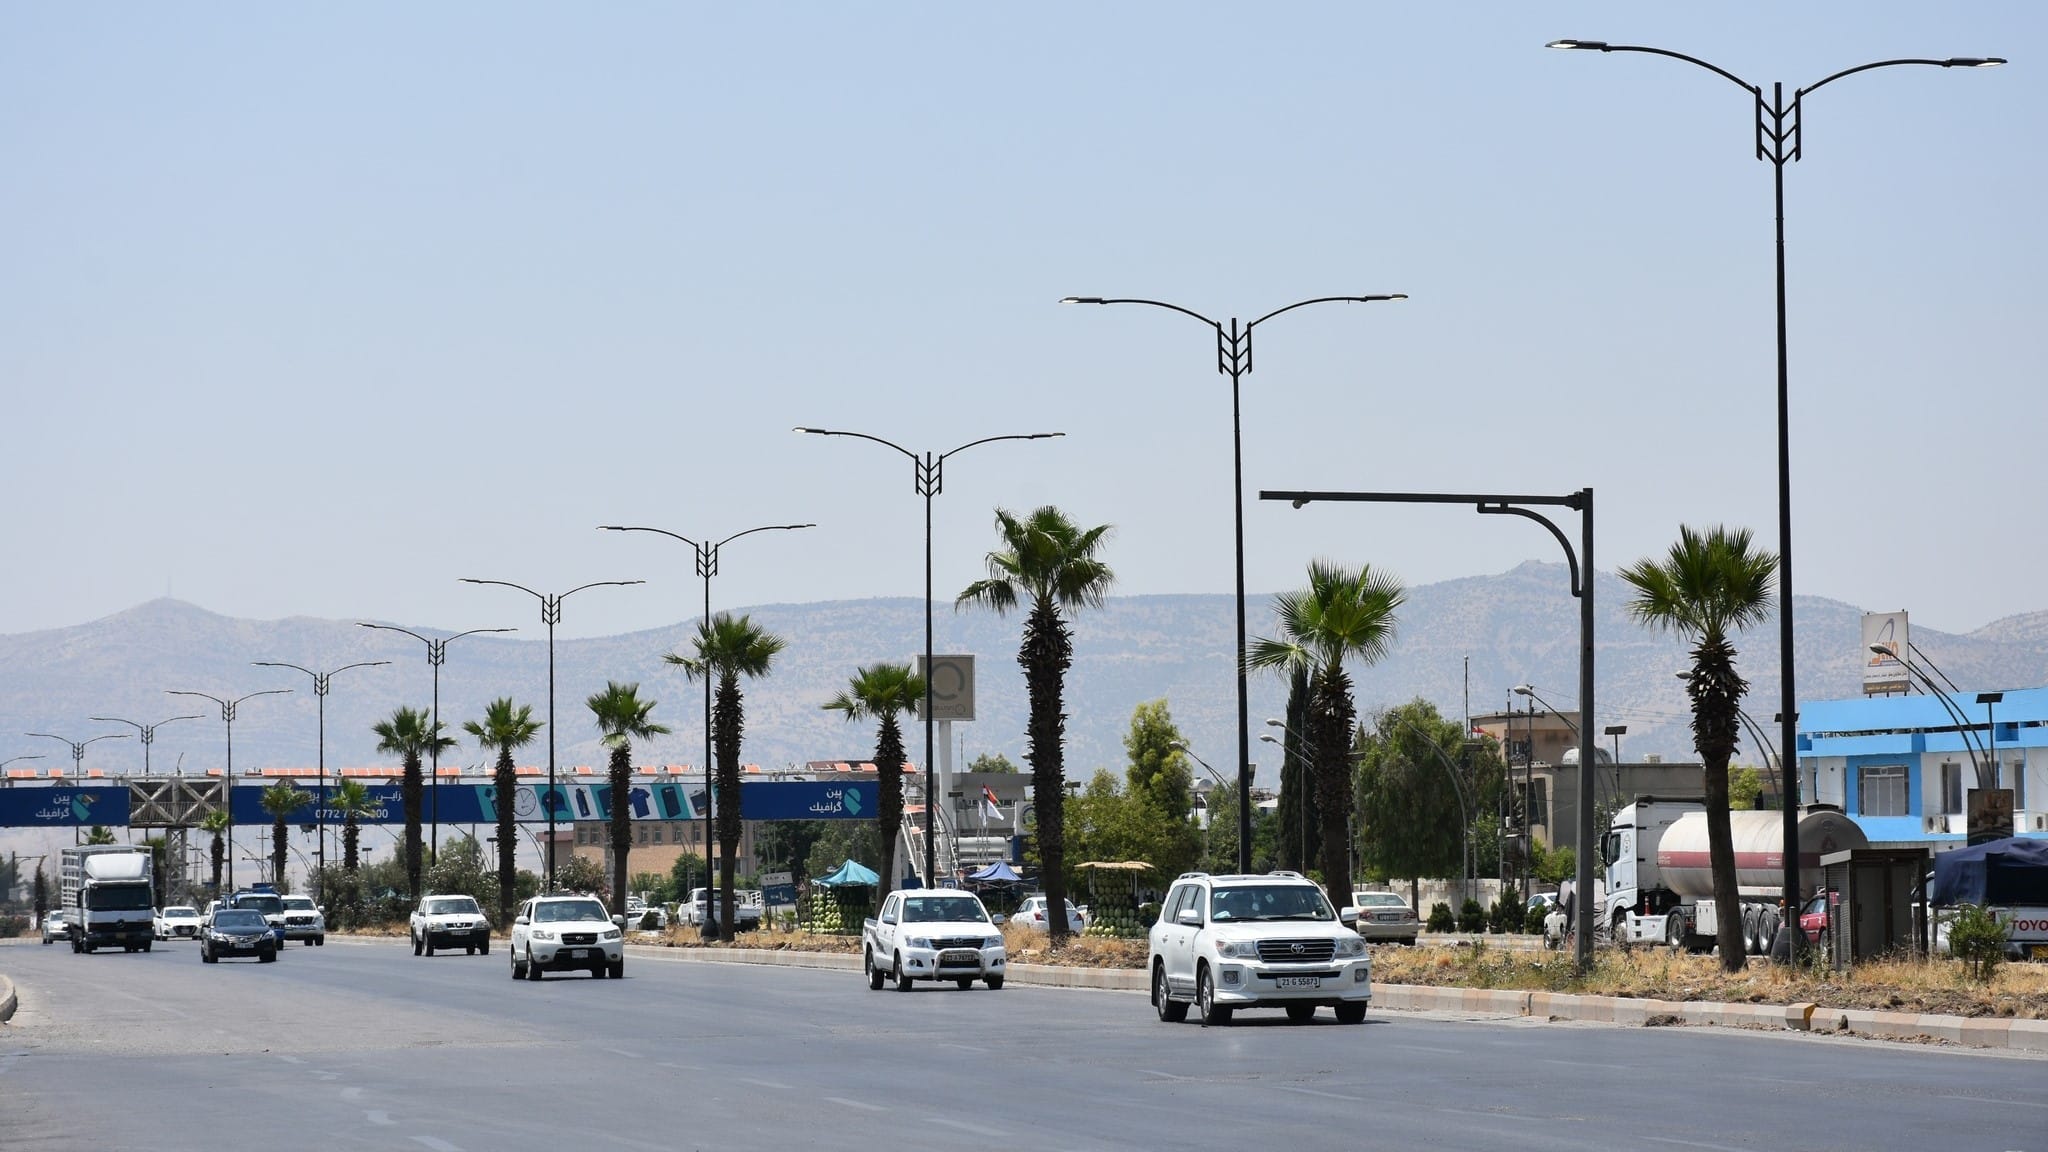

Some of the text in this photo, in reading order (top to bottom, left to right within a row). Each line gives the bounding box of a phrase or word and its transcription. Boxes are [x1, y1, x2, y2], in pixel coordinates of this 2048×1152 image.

[315, 809, 340, 818] 0772
[2012, 919, 2048, 931] TOYO
[1282, 978, 1290, 986] 21
